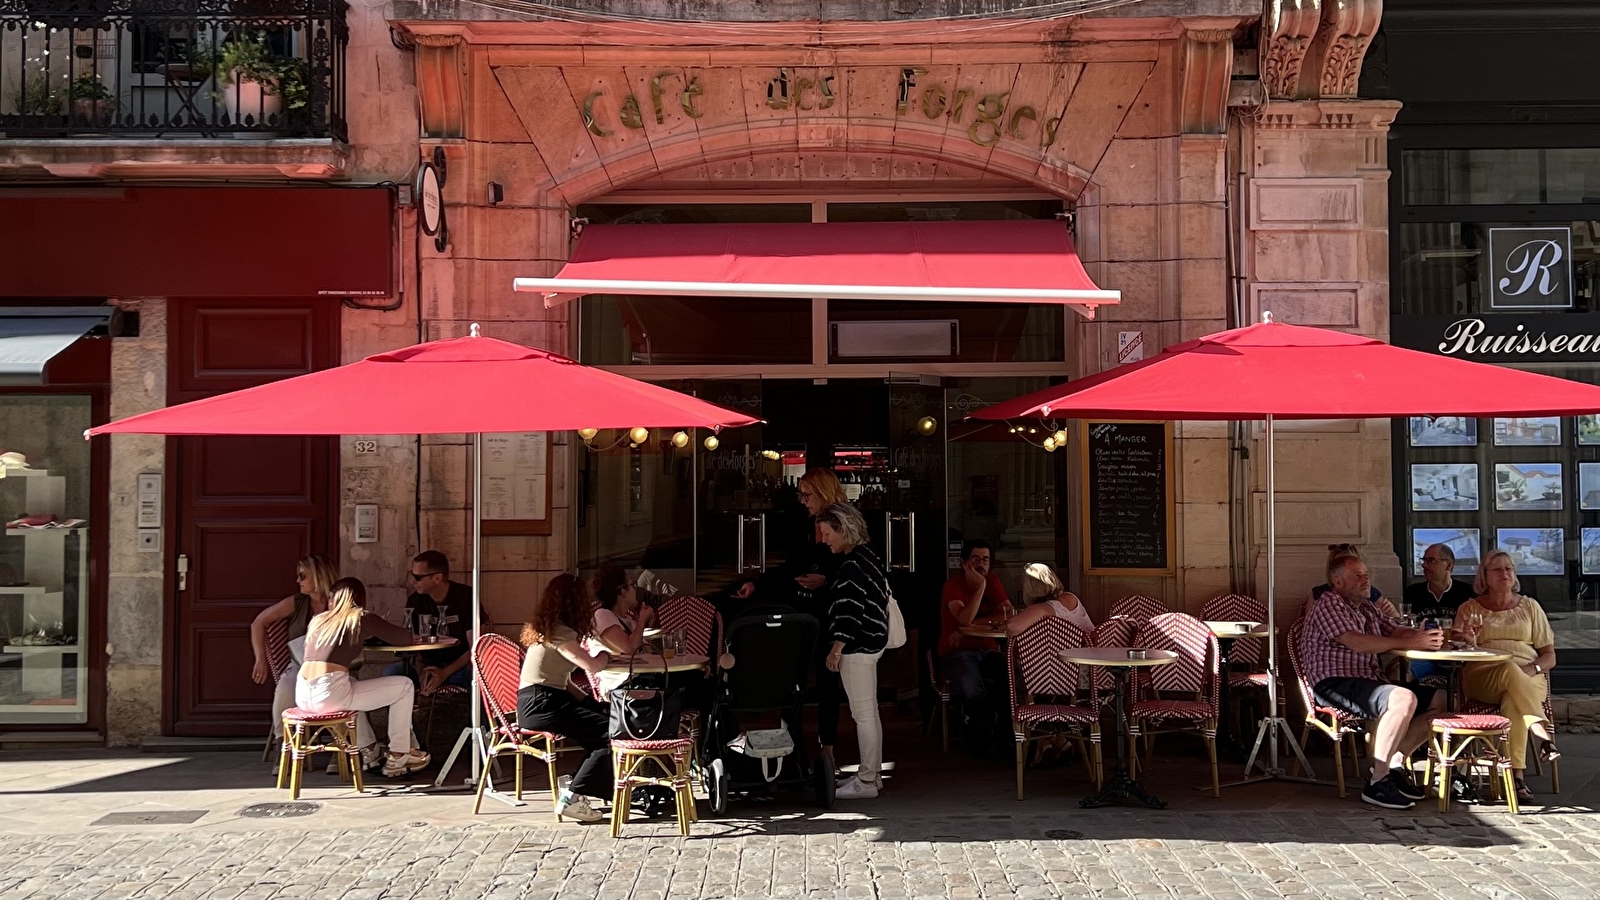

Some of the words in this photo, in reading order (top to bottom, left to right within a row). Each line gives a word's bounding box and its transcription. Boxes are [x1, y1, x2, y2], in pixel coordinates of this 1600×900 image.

[583, 70, 704, 138] Café
[767, 67, 836, 112] des
[898, 68, 1061, 148] Forges
[1499, 239, 1563, 296] R
[357, 441, 375, 453] 32
[1114, 433, 1147, 445] MANGER
